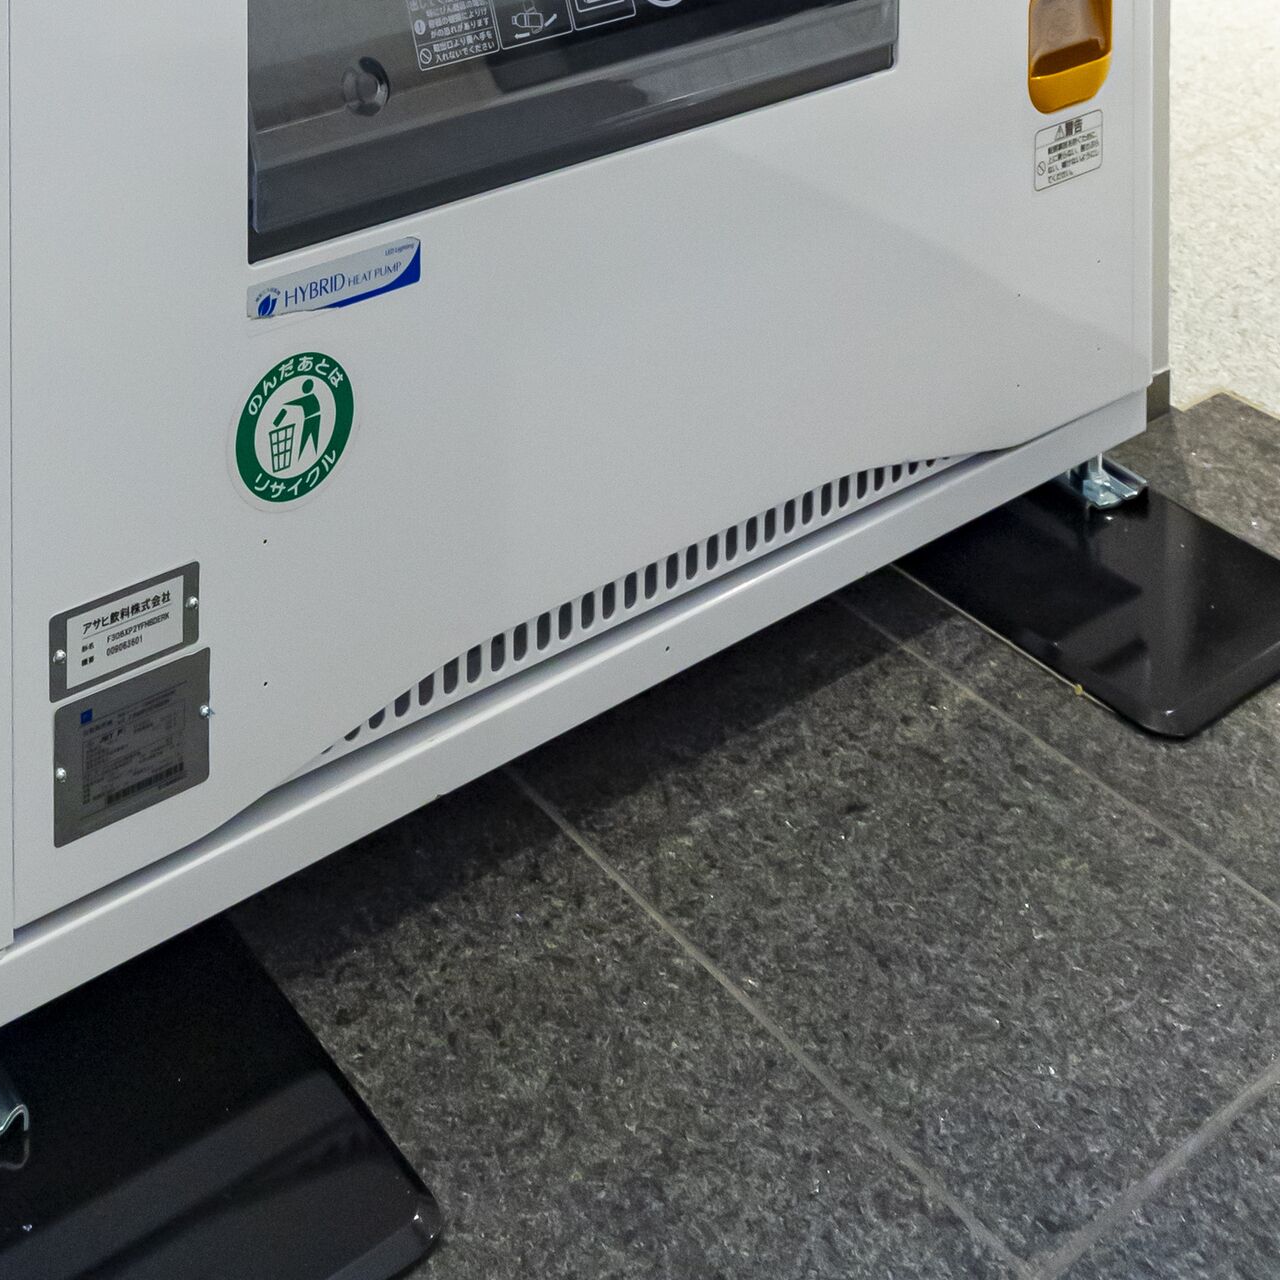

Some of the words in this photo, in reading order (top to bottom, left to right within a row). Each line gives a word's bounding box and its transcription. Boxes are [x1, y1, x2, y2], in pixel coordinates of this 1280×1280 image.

[284, 273, 347, 308] HYBRID
[348, 272, 372, 287] HEAT
[374, 261, 402, 280] PUMP
[247, 355, 344, 416] のんだあとは
[254, 448, 337, 499] リサイクル
[82, 590, 171, 635] アサヒ飲料株式会社
